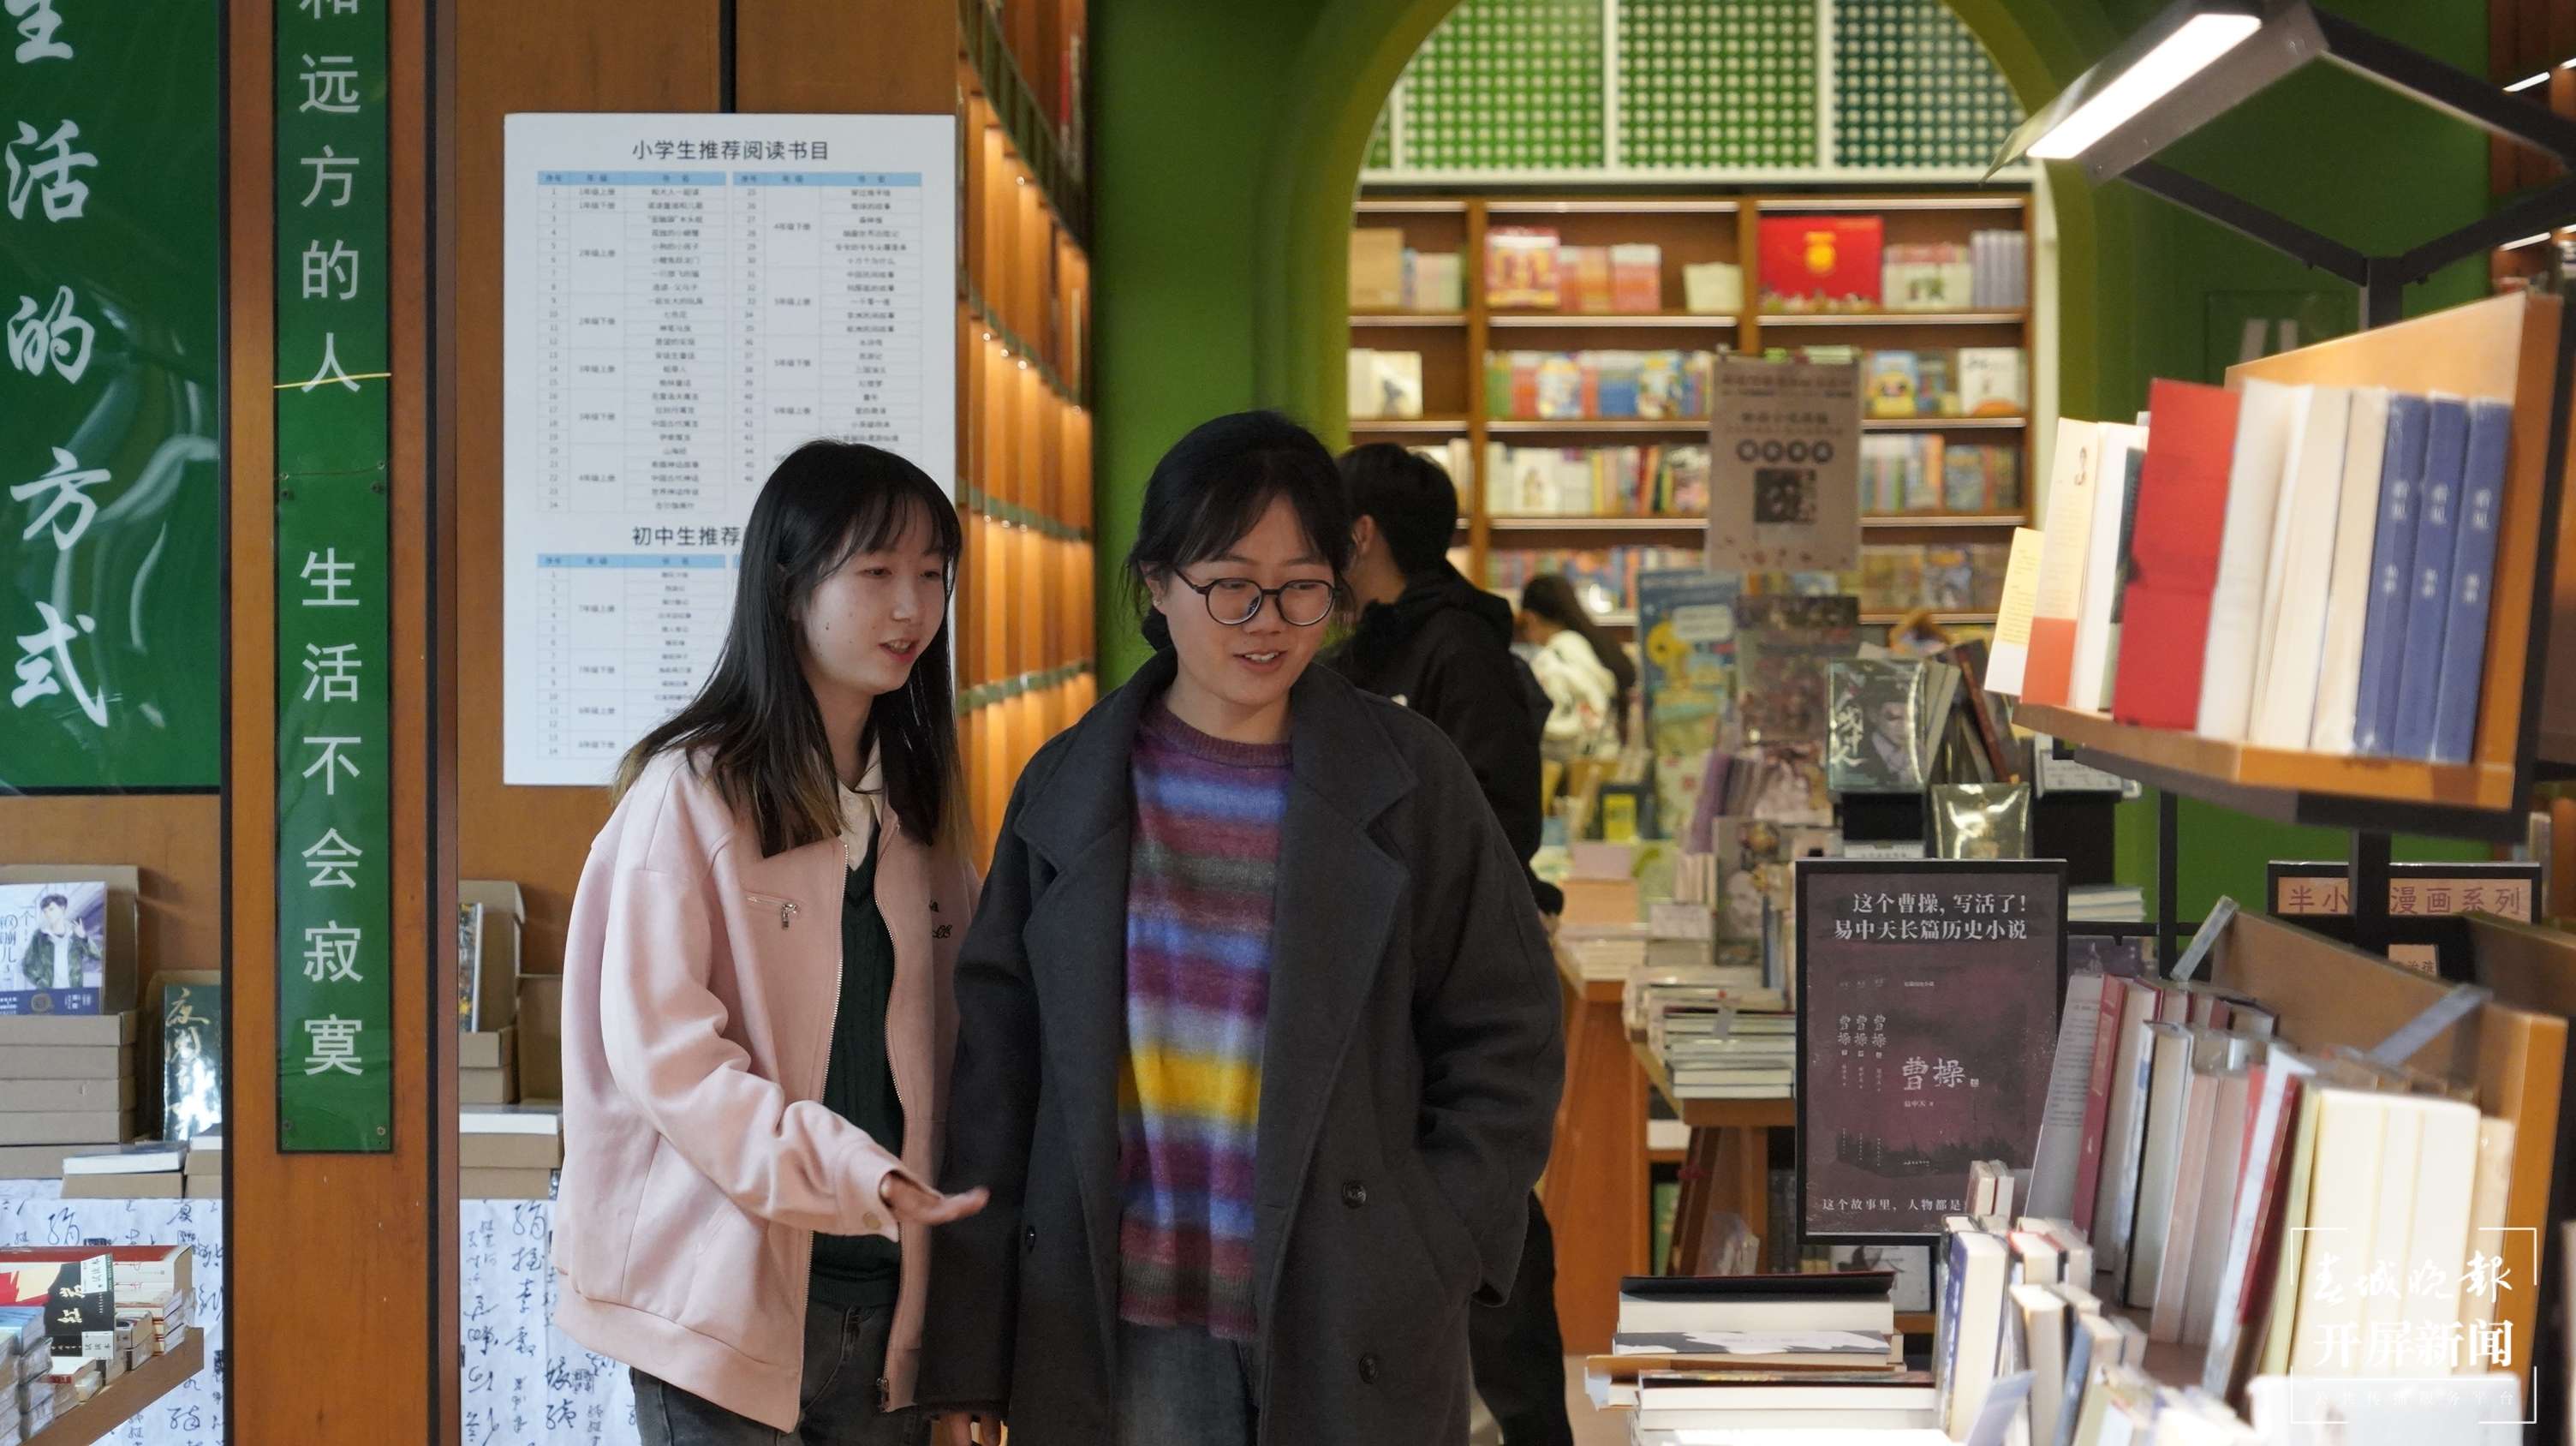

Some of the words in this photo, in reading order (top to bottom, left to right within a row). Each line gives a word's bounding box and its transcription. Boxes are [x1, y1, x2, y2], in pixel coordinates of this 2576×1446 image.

[632, 140, 829, 161] 小学生推荐阅读书目
[300, 0, 361, 392] 远方的人
[632, 526, 741, 547] 初中生推荐
[301, 548, 364, 1076] 生活不会寂寞
[1852, 893, 2027, 916] 这个曹操，写活了！
[2288, 885, 2520, 916] 半小漫画系列
[1834, 919, 2028, 941] 易中天长篇历史小说
[1902, 1056, 1967, 1090] 曹操
[1822, 1198, 1961, 1212] 这个故事里，人物都是
